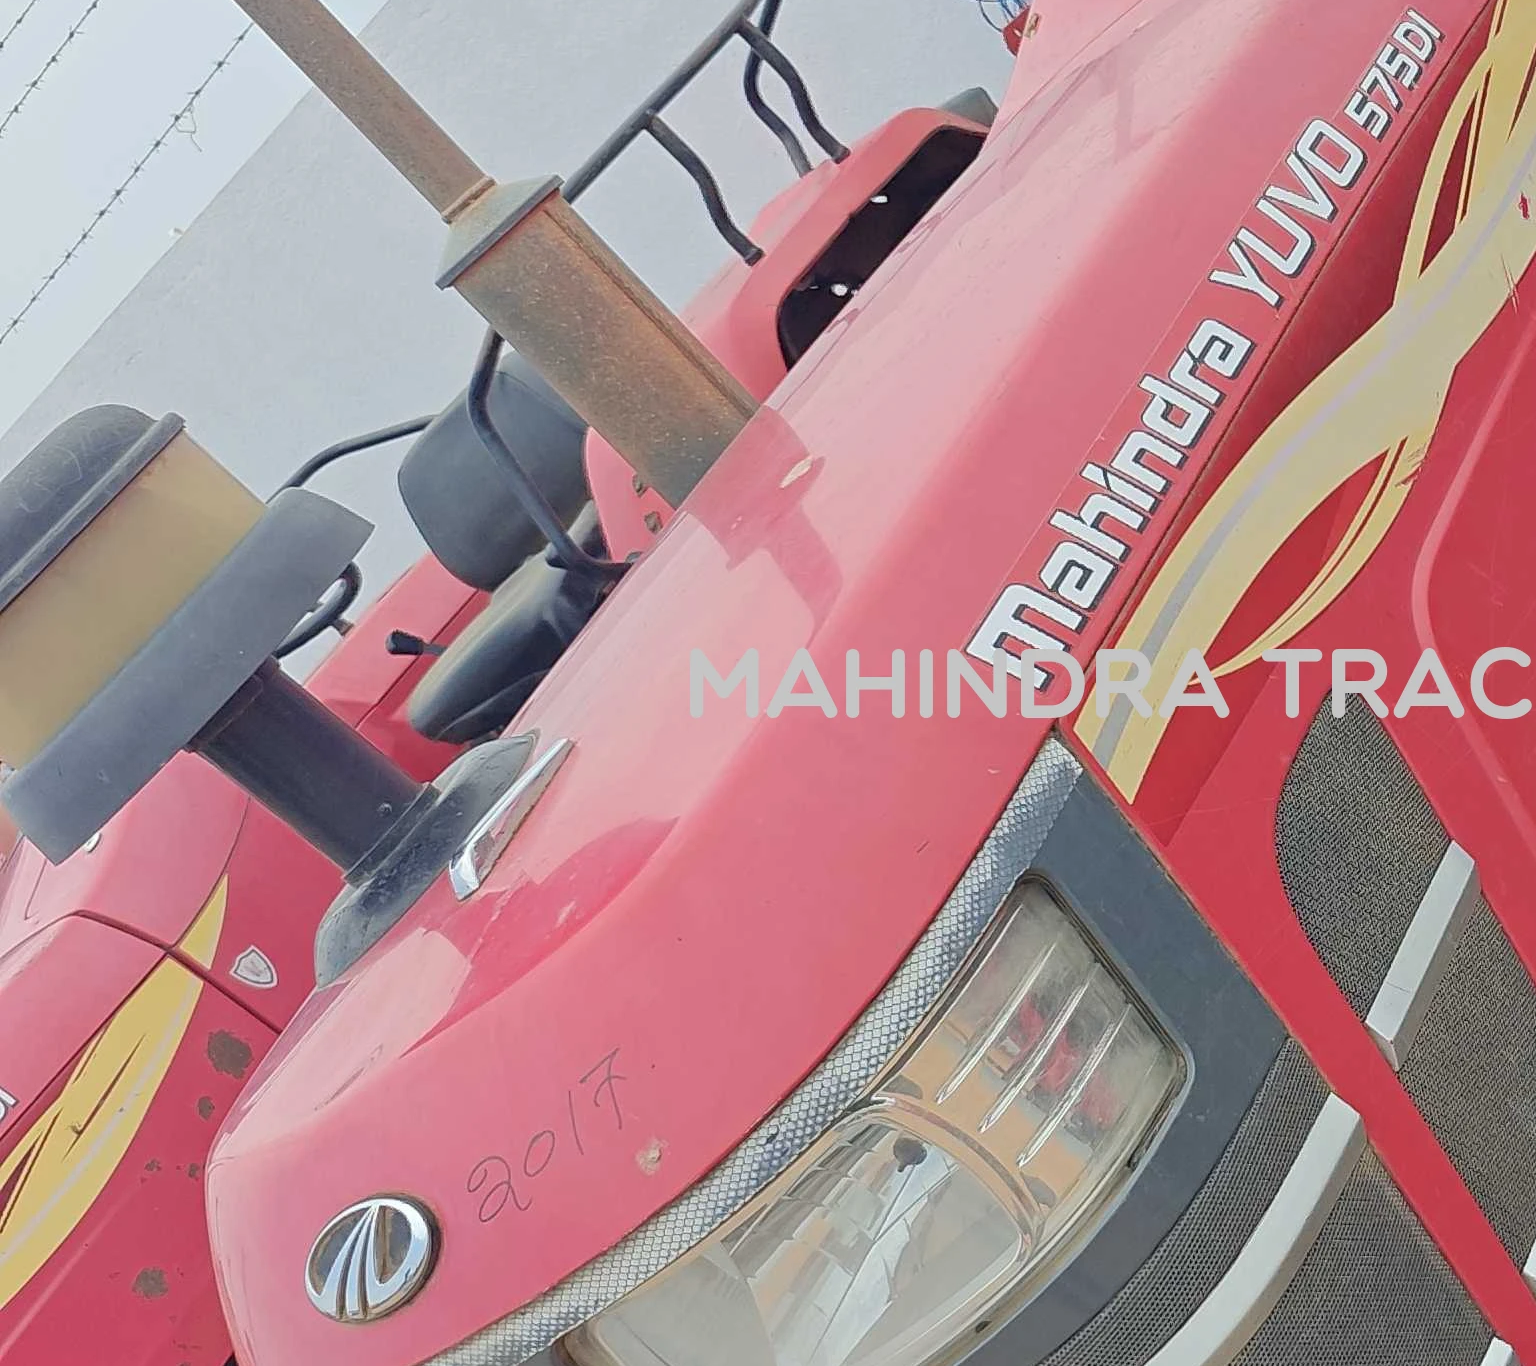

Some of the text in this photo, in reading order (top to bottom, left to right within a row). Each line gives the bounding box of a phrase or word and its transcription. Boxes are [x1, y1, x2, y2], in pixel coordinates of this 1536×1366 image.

[964, 6, 1446, 693] Mahindra YUVO 575DI
[467, 1047, 628, 1223] 2017
